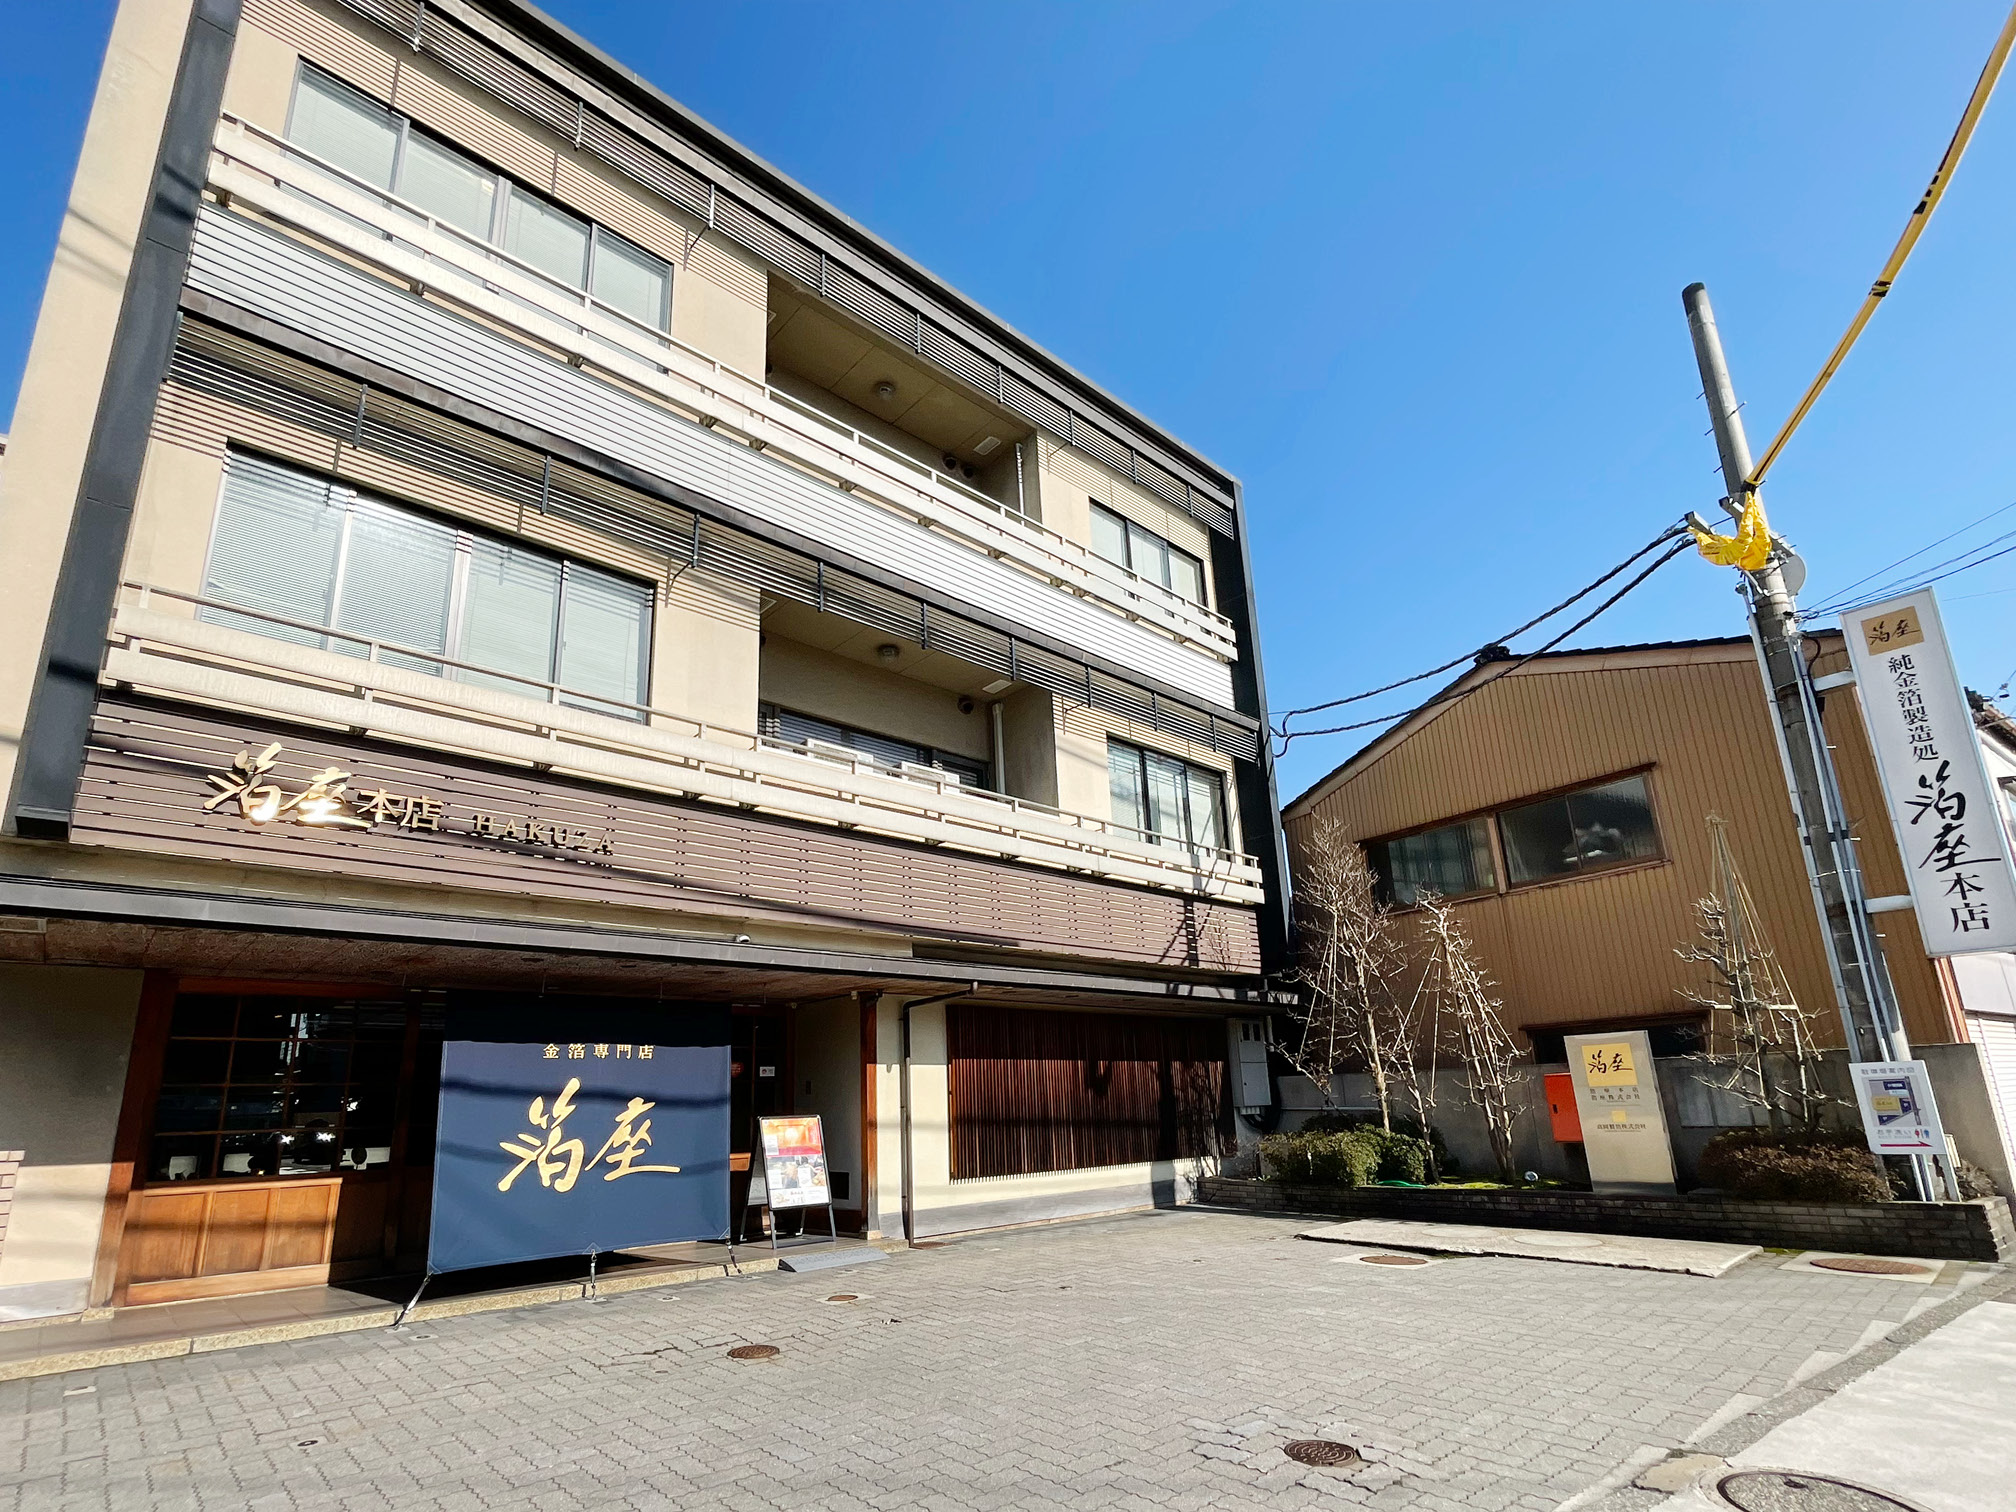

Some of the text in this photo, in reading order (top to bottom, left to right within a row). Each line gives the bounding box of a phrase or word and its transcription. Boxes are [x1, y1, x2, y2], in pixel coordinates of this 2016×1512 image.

[1868, 619, 1920, 645] 箔座
[1888, 654, 1940, 764] 純金箔製造処
[473, 812, 616, 853] HAKUZA
[1904, 760, 2002, 933] 箔座本店
[542, 1043, 656, 1060] 金箔専門店
[1588, 1049, 1634, 1074] 箔座
[497, 1076, 682, 1193] 箔座
